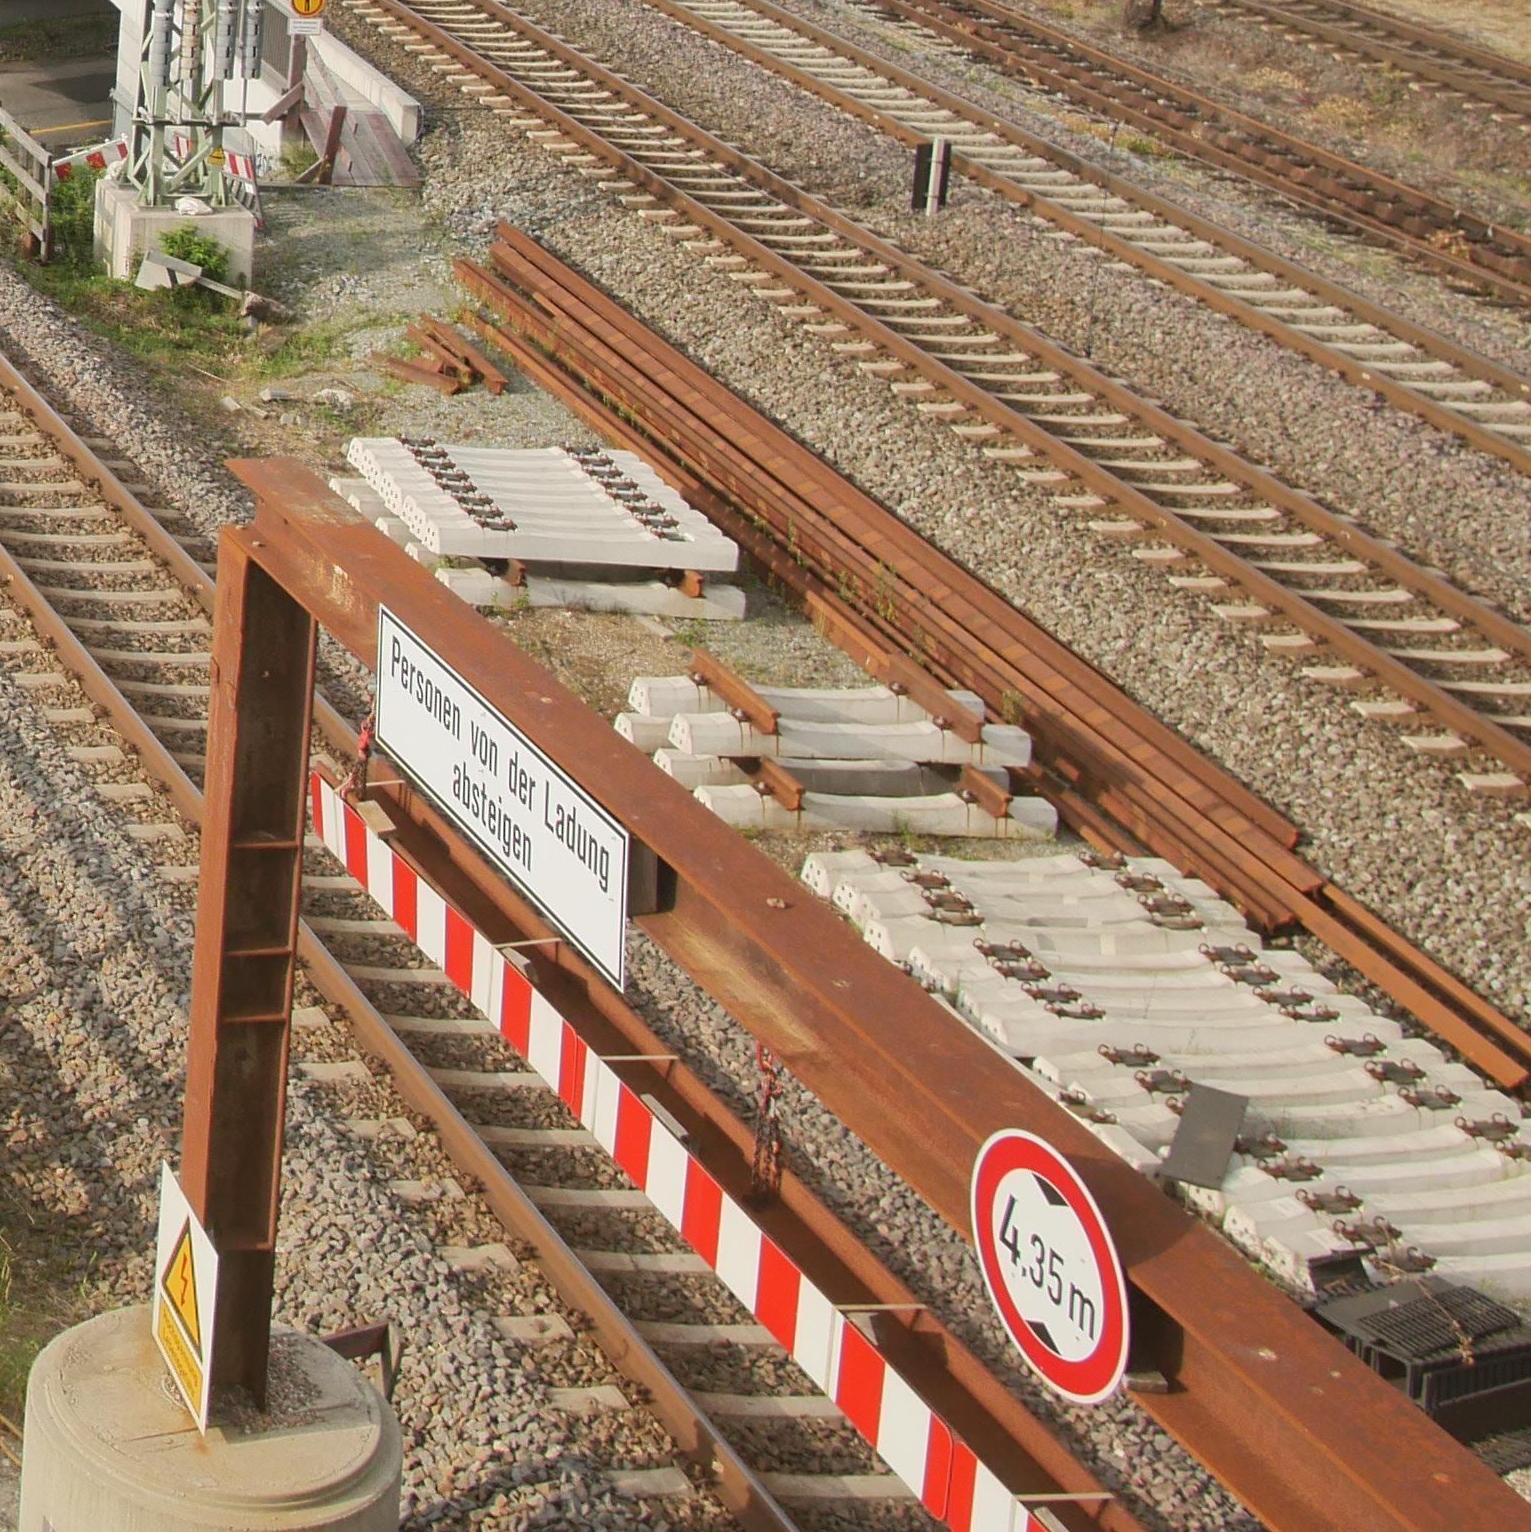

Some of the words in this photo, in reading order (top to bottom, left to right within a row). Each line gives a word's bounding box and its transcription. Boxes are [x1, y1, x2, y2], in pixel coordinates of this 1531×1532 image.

[391, 635, 461, 740] Personen
[471, 719, 499, 778] von
[508, 750, 536, 811] der
[544, 779, 611, 893] Ladung
[452, 761, 533, 873] absteigen
